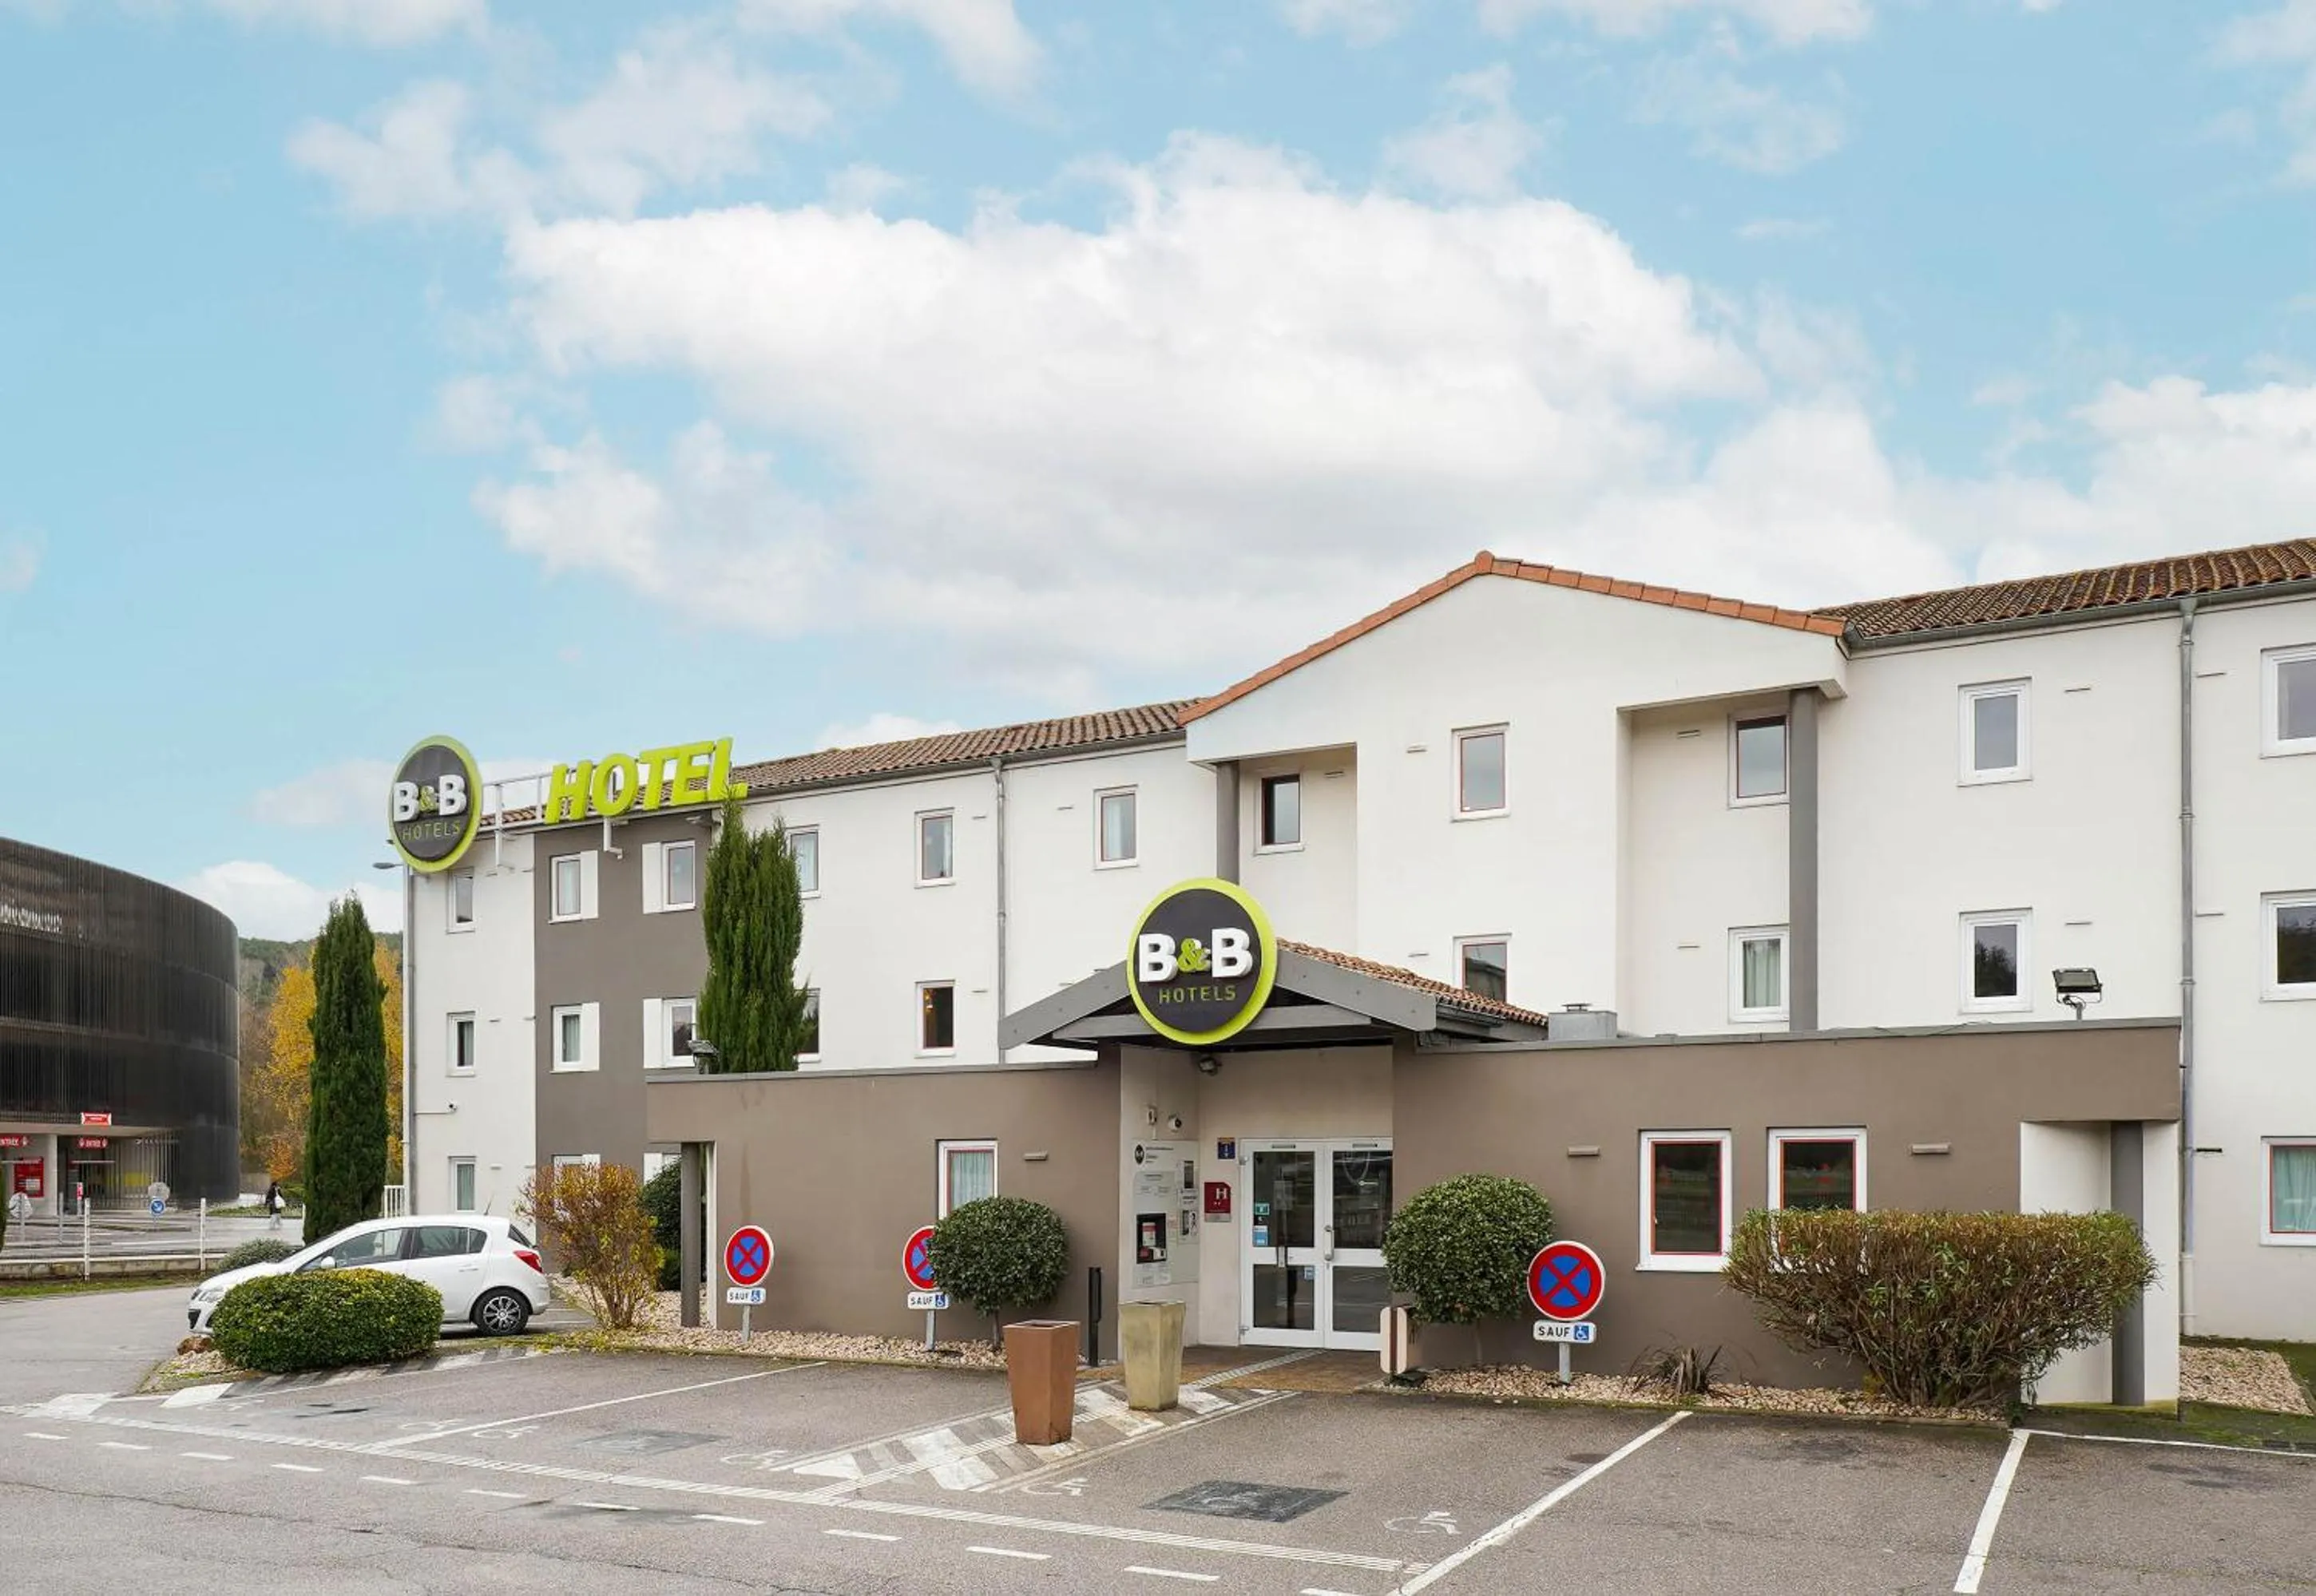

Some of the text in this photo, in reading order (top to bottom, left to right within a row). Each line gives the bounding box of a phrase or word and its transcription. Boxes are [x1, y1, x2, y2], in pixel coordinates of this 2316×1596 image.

[544, 736, 748, 825] HOTEL
[394, 774, 467, 822] B&B
[402, 820, 462, 841] HOTELS
[1139, 927, 1253, 983] B&B
[1159, 984, 1236, 1004] HOTELS
[1216, 1187, 1227, 1200] H
[729, 1291, 749, 1301] SAUF
[910, 1296, 934, 1305] SAUF
[1538, 1325, 1570, 1337] SAUF
